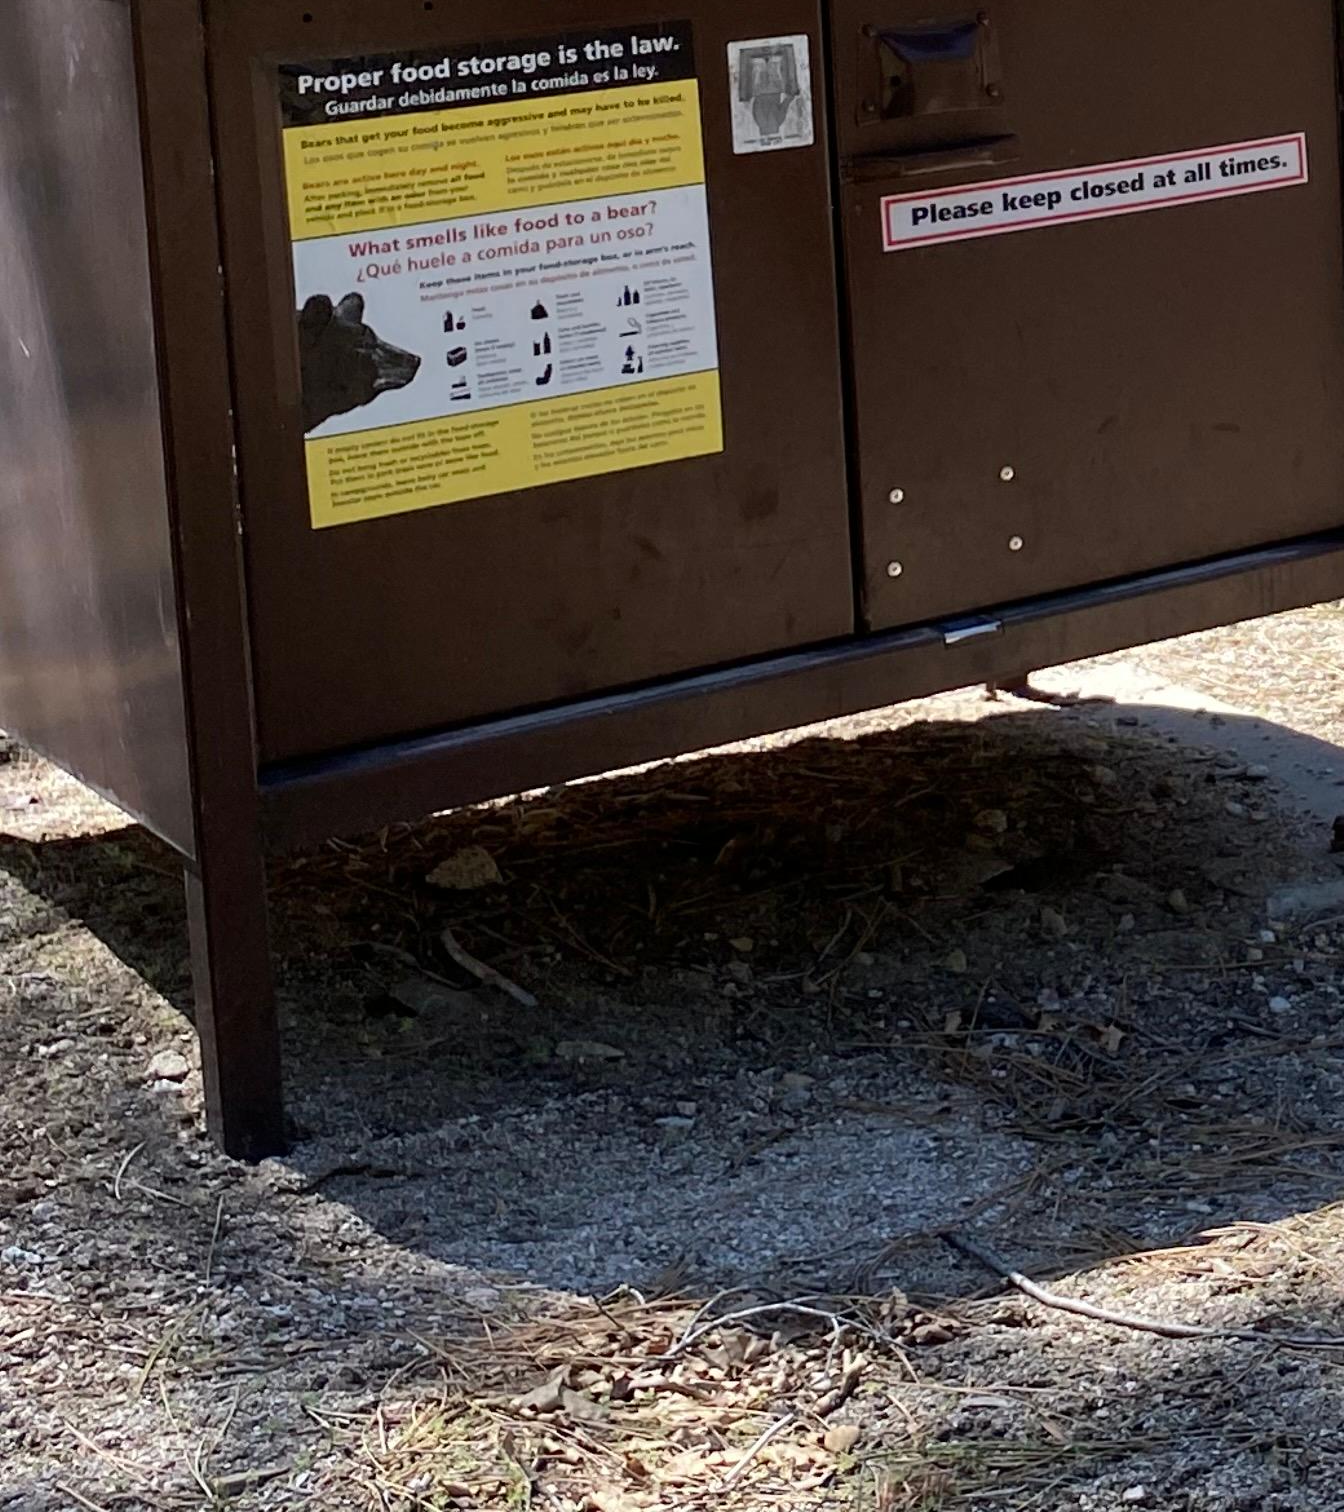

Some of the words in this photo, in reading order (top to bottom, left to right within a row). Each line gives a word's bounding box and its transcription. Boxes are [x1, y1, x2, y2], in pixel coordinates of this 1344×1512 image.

[298, 68, 384, 94] Proper
[391, 57, 451, 83] food
[457, 51, 551, 76] storage
[558, 45, 578, 64] is
[583, 40, 624, 61] the
[631, 36, 680, 55] law.
[325, 95, 395, 116] Guardar
[399, 82, 508, 107] debidamente
[512, 79, 527, 94] la
[531, 71, 589, 91] comida
[593, 70, 610, 84] es
[614, 66, 629, 81] la
[632, 63, 660, 80] ley.
[911, 200, 993, 226] Please
[1001, 189, 1062, 212] keep
[1070, 173, 1145, 202] closed
[1152, 169, 1177, 188] at
[1183, 163, 1211, 185] all
[1219, 151, 1288, 178] times.
[349, 238, 400, 258] What
[406, 229, 467, 250] smells
[473, 221, 508, 240] like
[514, 214, 559, 233] food
[565, 212, 585, 225] to
[591, 210, 602, 222] a
[607, 200, 657, 219] bear?
[356, 257, 402, 283] ¿Qué
[407, 252, 456, 272] huele
[462, 252, 472, 263] a
[477, 239, 540, 262] comida
[546, 233, 584, 254] para
[590, 230, 612, 243] un
[616, 222, 655, 240] oso?
